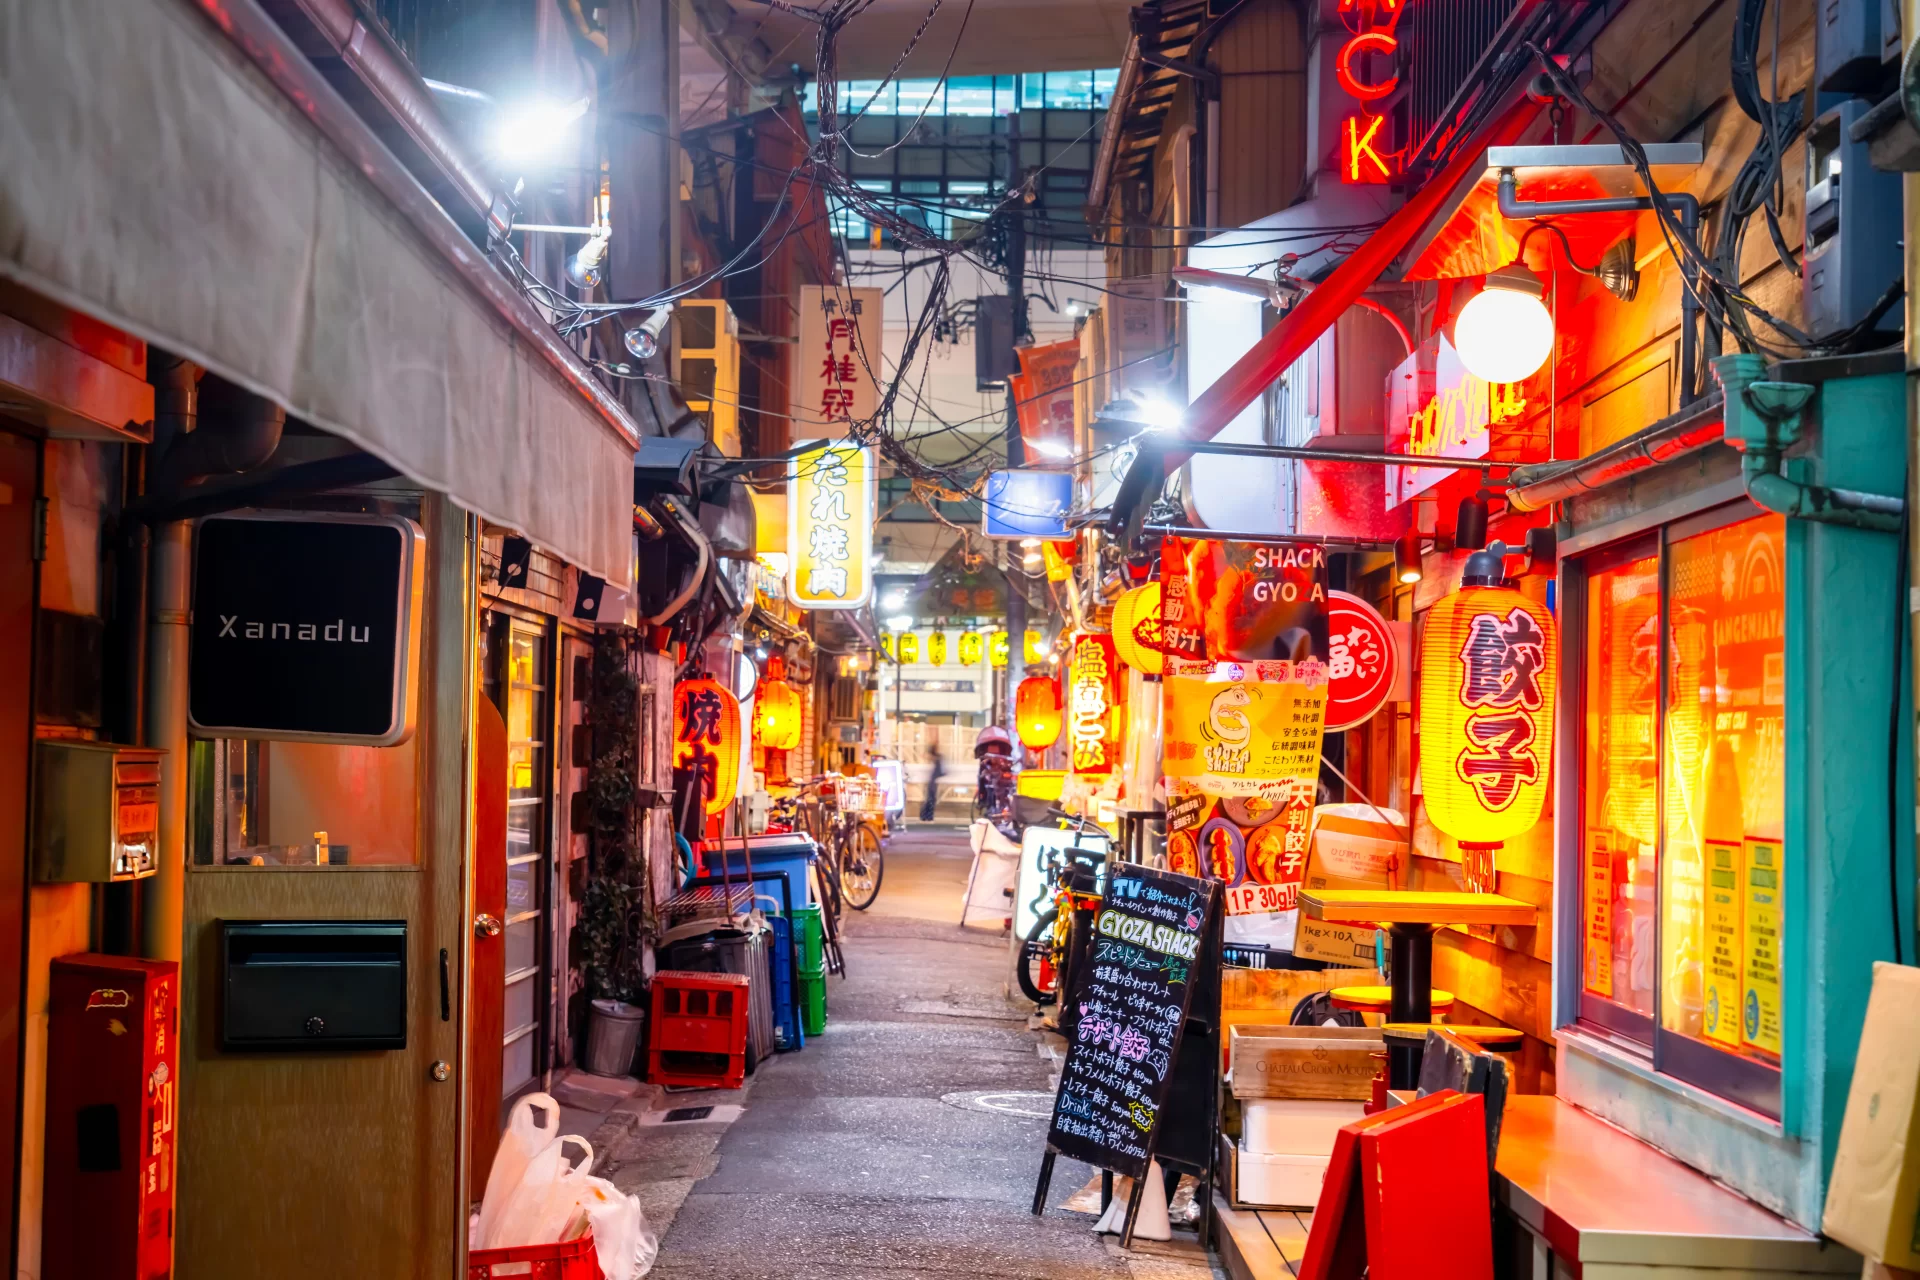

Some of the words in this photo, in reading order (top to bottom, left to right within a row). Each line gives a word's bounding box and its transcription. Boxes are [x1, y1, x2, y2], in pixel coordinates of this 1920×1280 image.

[1337, 0, 1402, 183] CK
[819, 319, 858, 422] 月桂冠
[809, 449, 851, 597] たれ焼肉
[1254, 547, 1325, 569] SHACK
[1253, 582, 1325, 602] GYOZA
[218, 614, 369, 643] Xanadu
[1459, 607, 1545, 812] 餃子
[1203, 744, 1251, 763] GYOZA
[1281, 786, 1312, 875] 大判餃子
[1061, 1093, 1090, 1117] Drink
